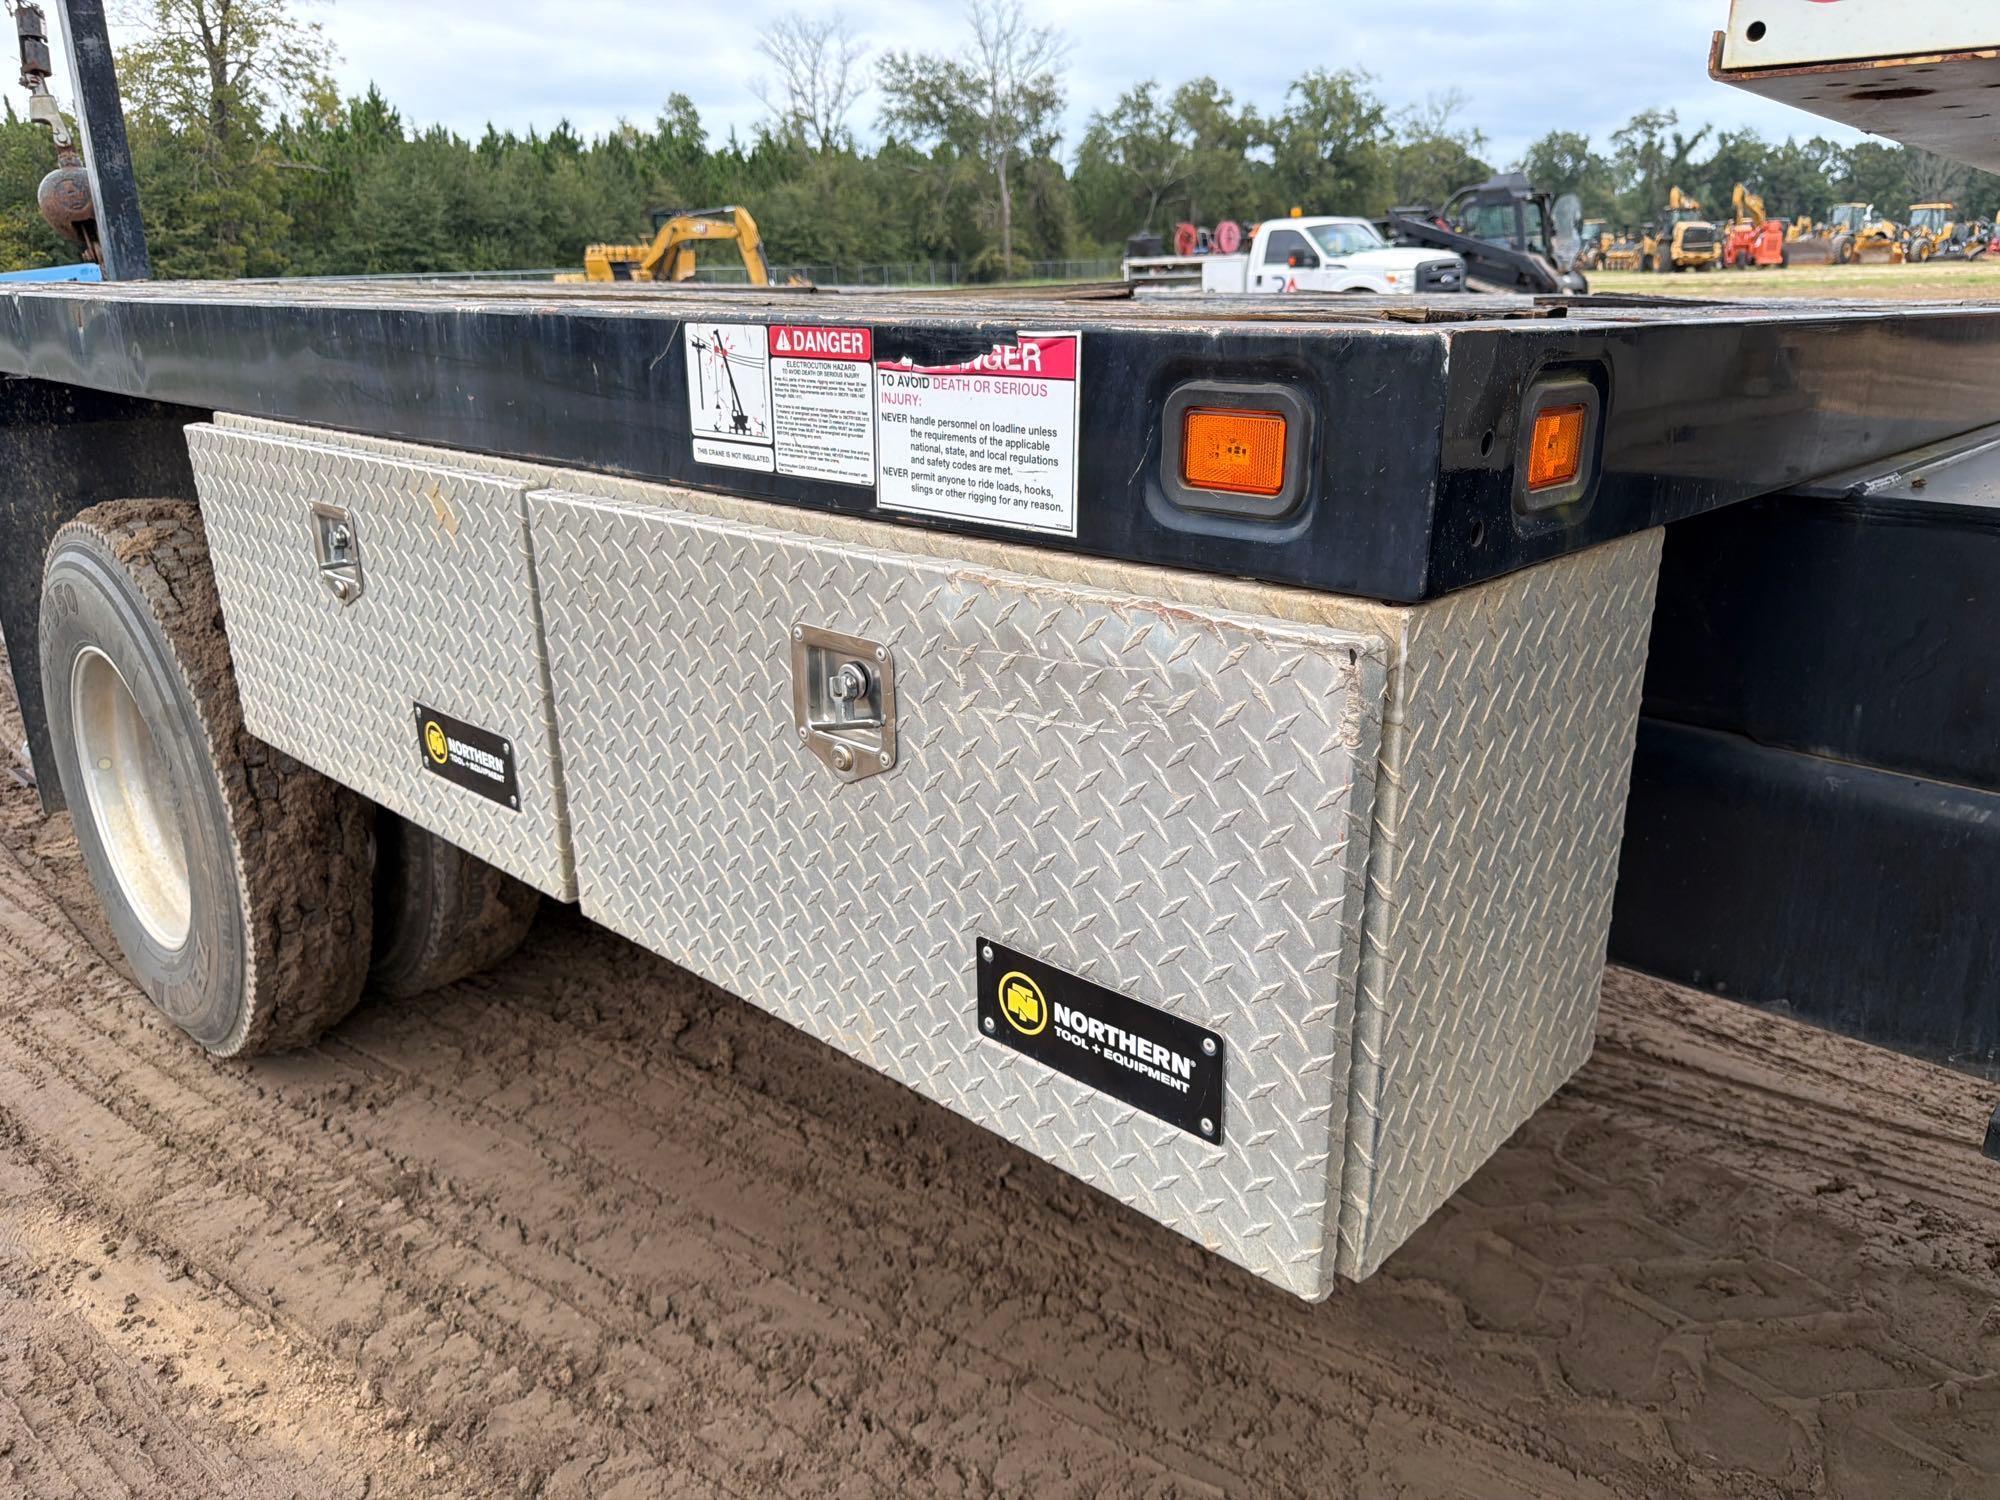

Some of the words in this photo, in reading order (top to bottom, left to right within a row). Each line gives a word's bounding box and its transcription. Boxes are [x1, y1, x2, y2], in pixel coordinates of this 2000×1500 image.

[793, 331, 863, 354] DANGER
[787, 361, 831, 369] ELECTROCUTION
[881, 374, 895, 386] TO
[898, 375, 930, 389] AVOID
[933, 378, 970, 392] DEATH
[974, 380, 991, 392] OR
[994, 381, 1048, 397] SERIOUS
[881, 392, 922, 406] INJURY:
[881, 413, 908, 423] NEVER
[910, 415, 936, 426] handle
[937, 418, 977, 430] personnel
[980, 422, 990, 430] on
[992, 422, 1026, 434] loadline
[1028, 426, 1057, 437] unless
[910, 429, 922, 438] the
[924, 431, 977, 444] requirements
[979, 435, 987, 444] of
[989, 436, 1002, 446] the
[1005, 439, 1050, 451] applicable
[709, 449, 725, 457] CRANE
[910, 443, 943, 455] national,
[945, 447, 967, 458] state,
[969, 449, 985, 459] and
[987, 450, 1007, 461] local
[1009, 453, 1059, 467] regulations
[910, 456, 925, 465] and
[927, 458, 950, 470] safety
[952, 461, 976, 471] codes
[979, 464, 992, 473] are
[994, 465, 1013, 475] met.
[883, 467, 908, 478] NEVER
[911, 472, 936, 482] permit
[937, 475, 966, 486] anyone
[968, 477, 976, 486] to
[978, 479, 994, 490] ride
[996, 482, 1022, 494] loads,
[1024, 484, 1054, 498] hooks,
[911, 484, 933, 495] slings
[935, 487, 943, 495] or
[945, 488, 966, 499] other
[968, 491, 997, 505] rigging
[999, 494, 1011, 504] for
[1013, 497, 1028, 509] any
[1031, 500, 1064, 513] reason.
[447, 737, 504, 773] NORTHERN
[450, 754, 466, 767] TOOL
[469, 762, 505, 783] EQUIPMENT
[1054, 1002, 1190, 1079] NORTHERN
[1054, 1025, 1089, 1050] TOOL
[1104, 1048, 1190, 1094] EQUIPMENT
